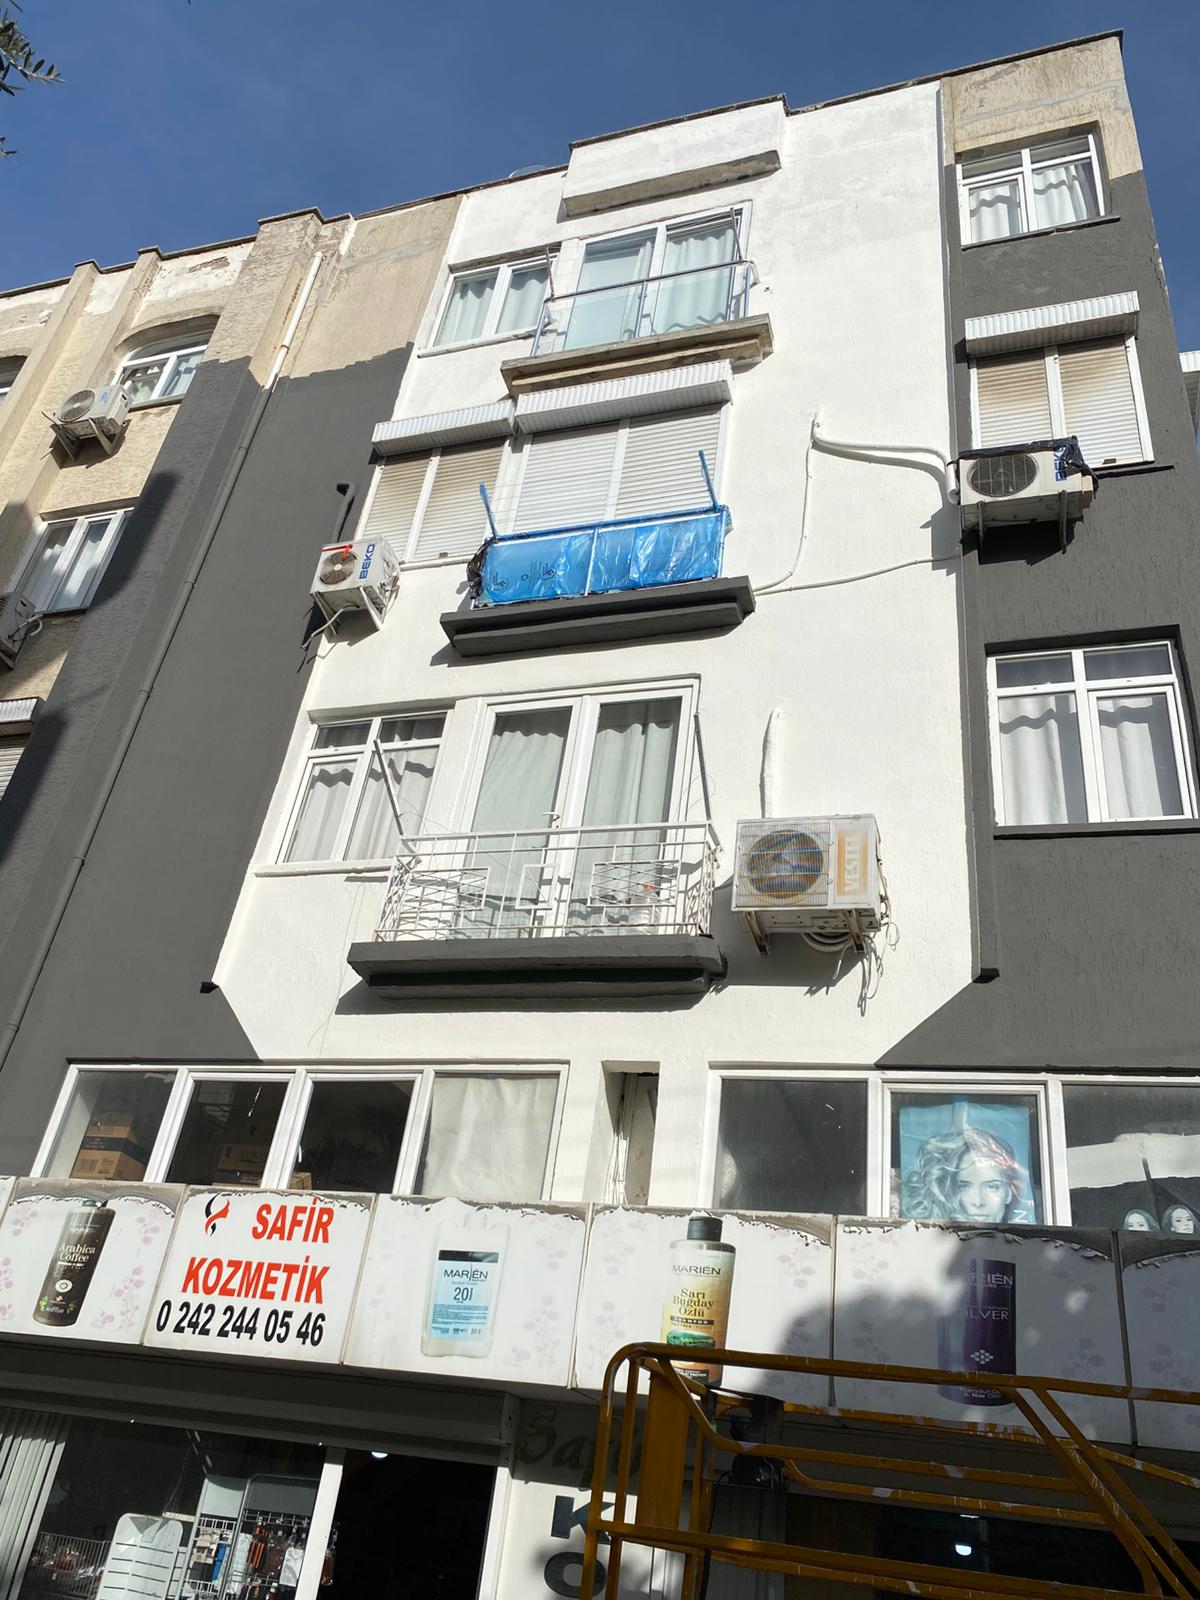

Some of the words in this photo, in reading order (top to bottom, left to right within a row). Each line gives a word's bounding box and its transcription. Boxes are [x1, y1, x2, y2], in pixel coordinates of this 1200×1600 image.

[357, 543, 376, 580] BEKO
[251, 1197, 335, 1244] SAFİR
[59, 1252, 89, 1263] Coffee
[181, 1254, 330, 1305] KOZMETİK
[155, 1299, 172, 1333] 0
[173, 1302, 216, 1337] 242
[217, 1305, 261, 1341] 244
[264, 1309, 292, 1344] 05
[296, 1312, 327, 1347] 46
[965, 1309, 1009, 1321] ILVER
